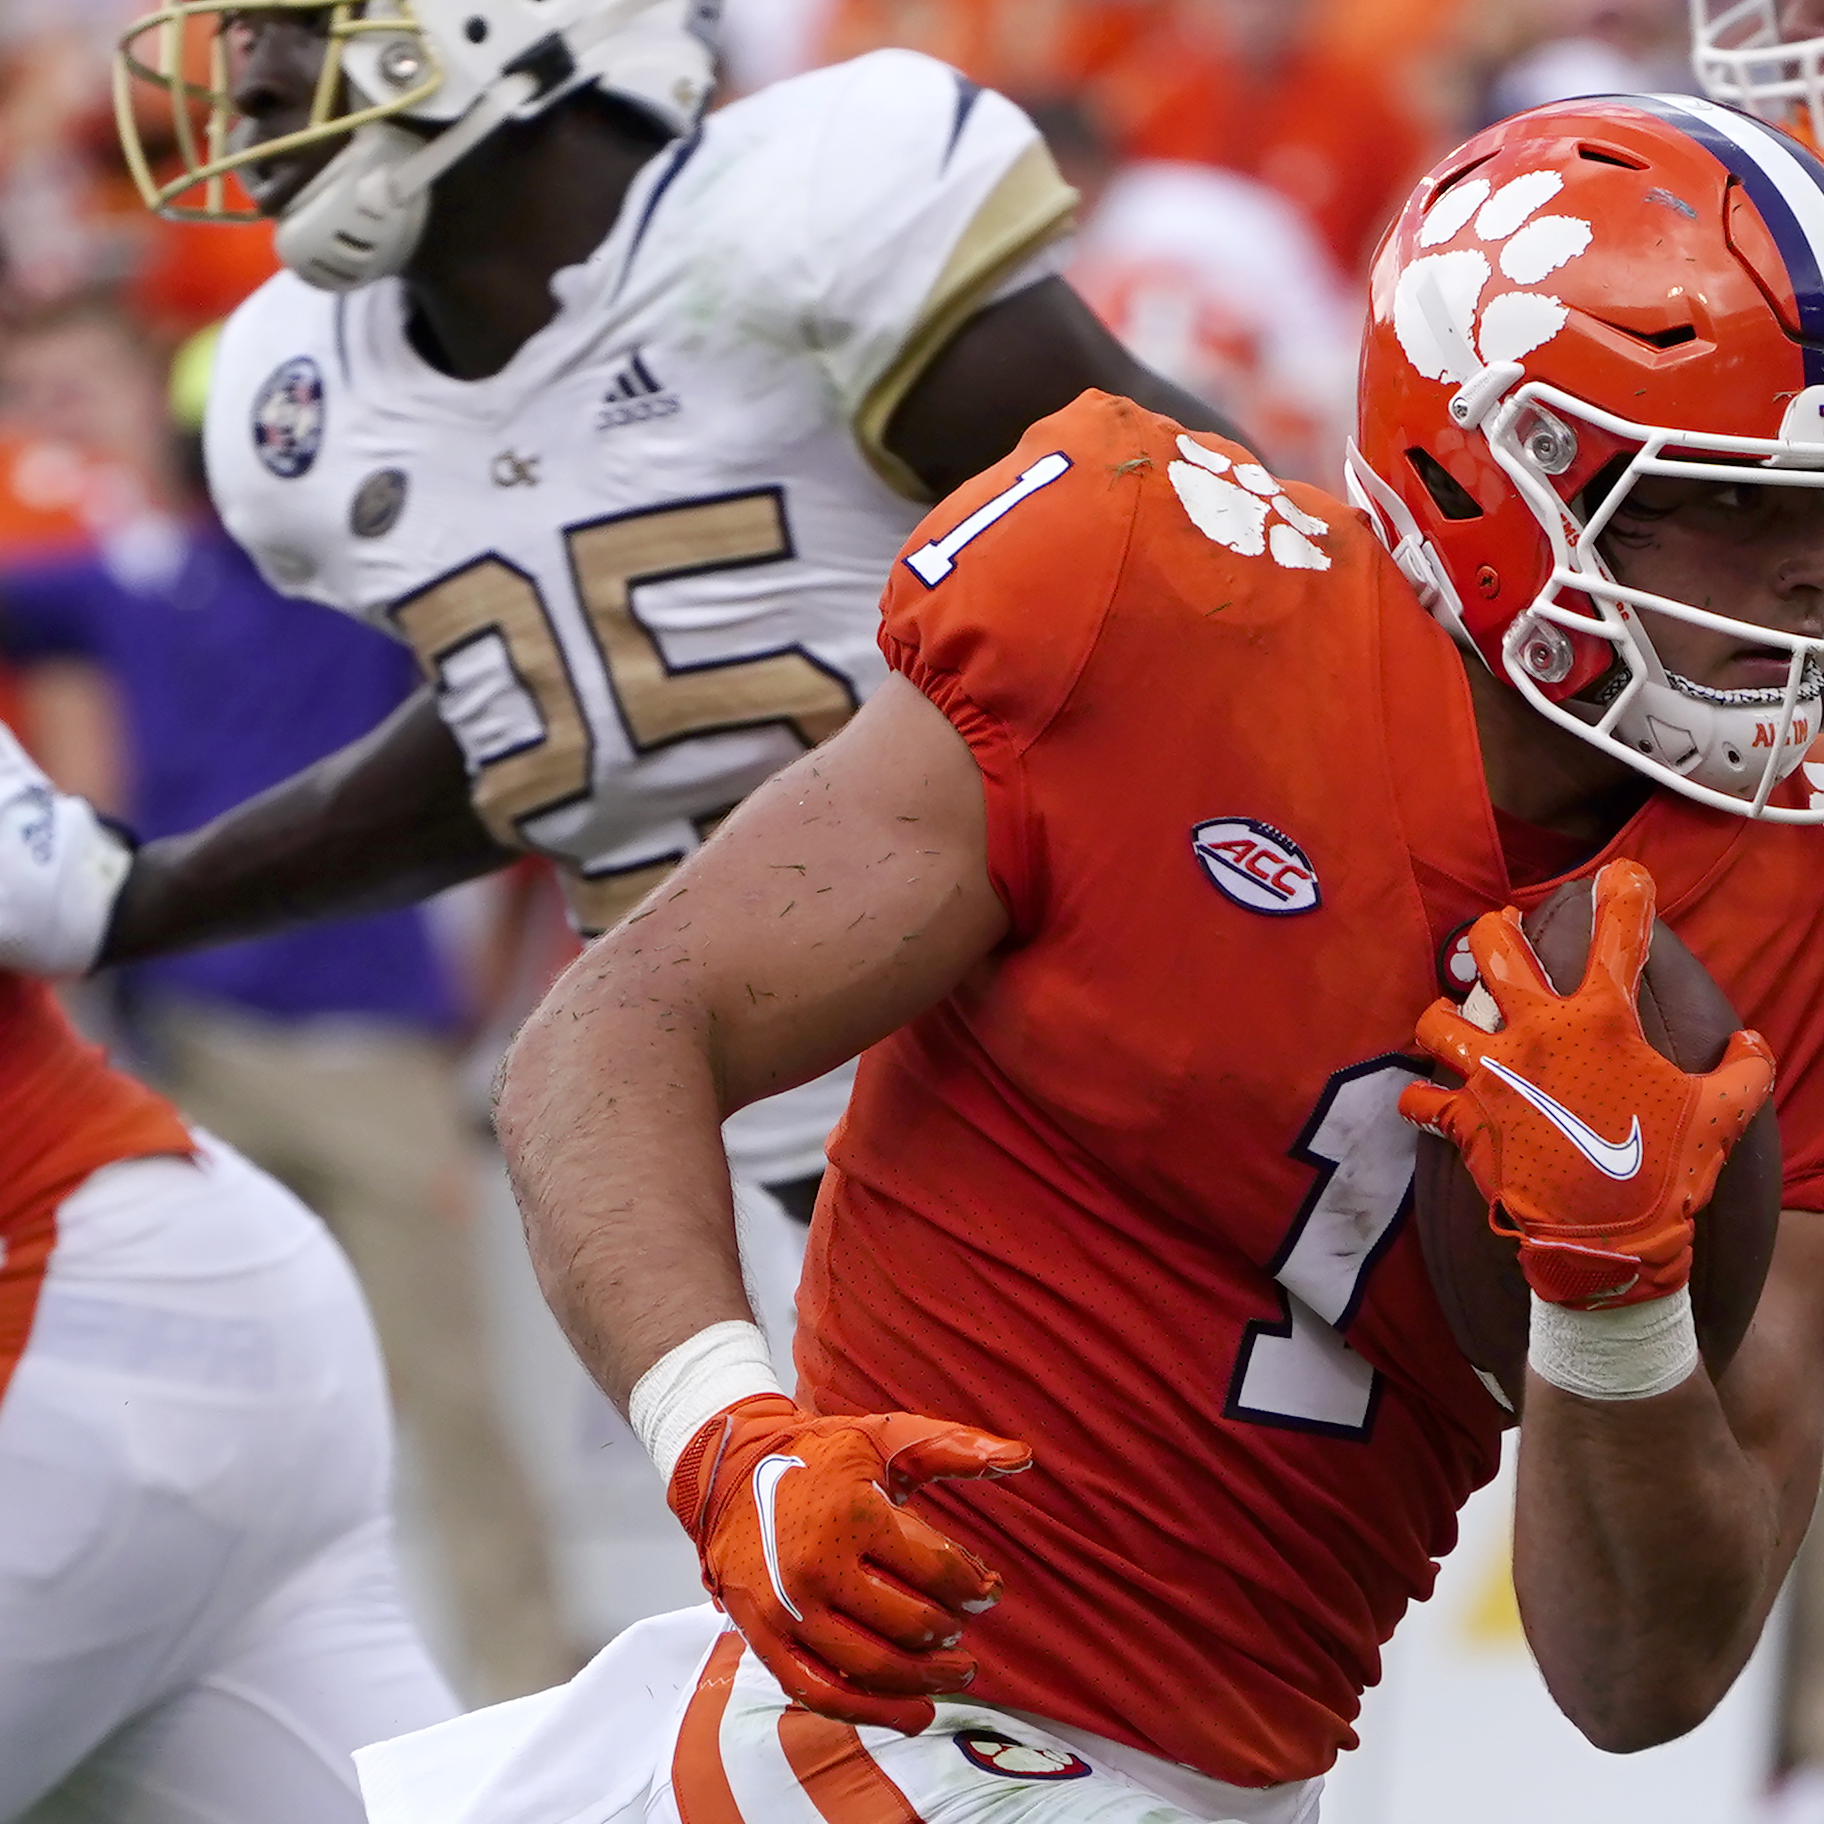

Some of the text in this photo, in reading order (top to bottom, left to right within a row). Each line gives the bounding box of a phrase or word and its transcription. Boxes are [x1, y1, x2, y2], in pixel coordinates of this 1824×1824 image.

[901, 450, 1075, 592] 1
[1751, 722, 1791, 748] AL
[1208, 839, 1312, 896] ACC
[1221, 1050, 1437, 1446] 1
